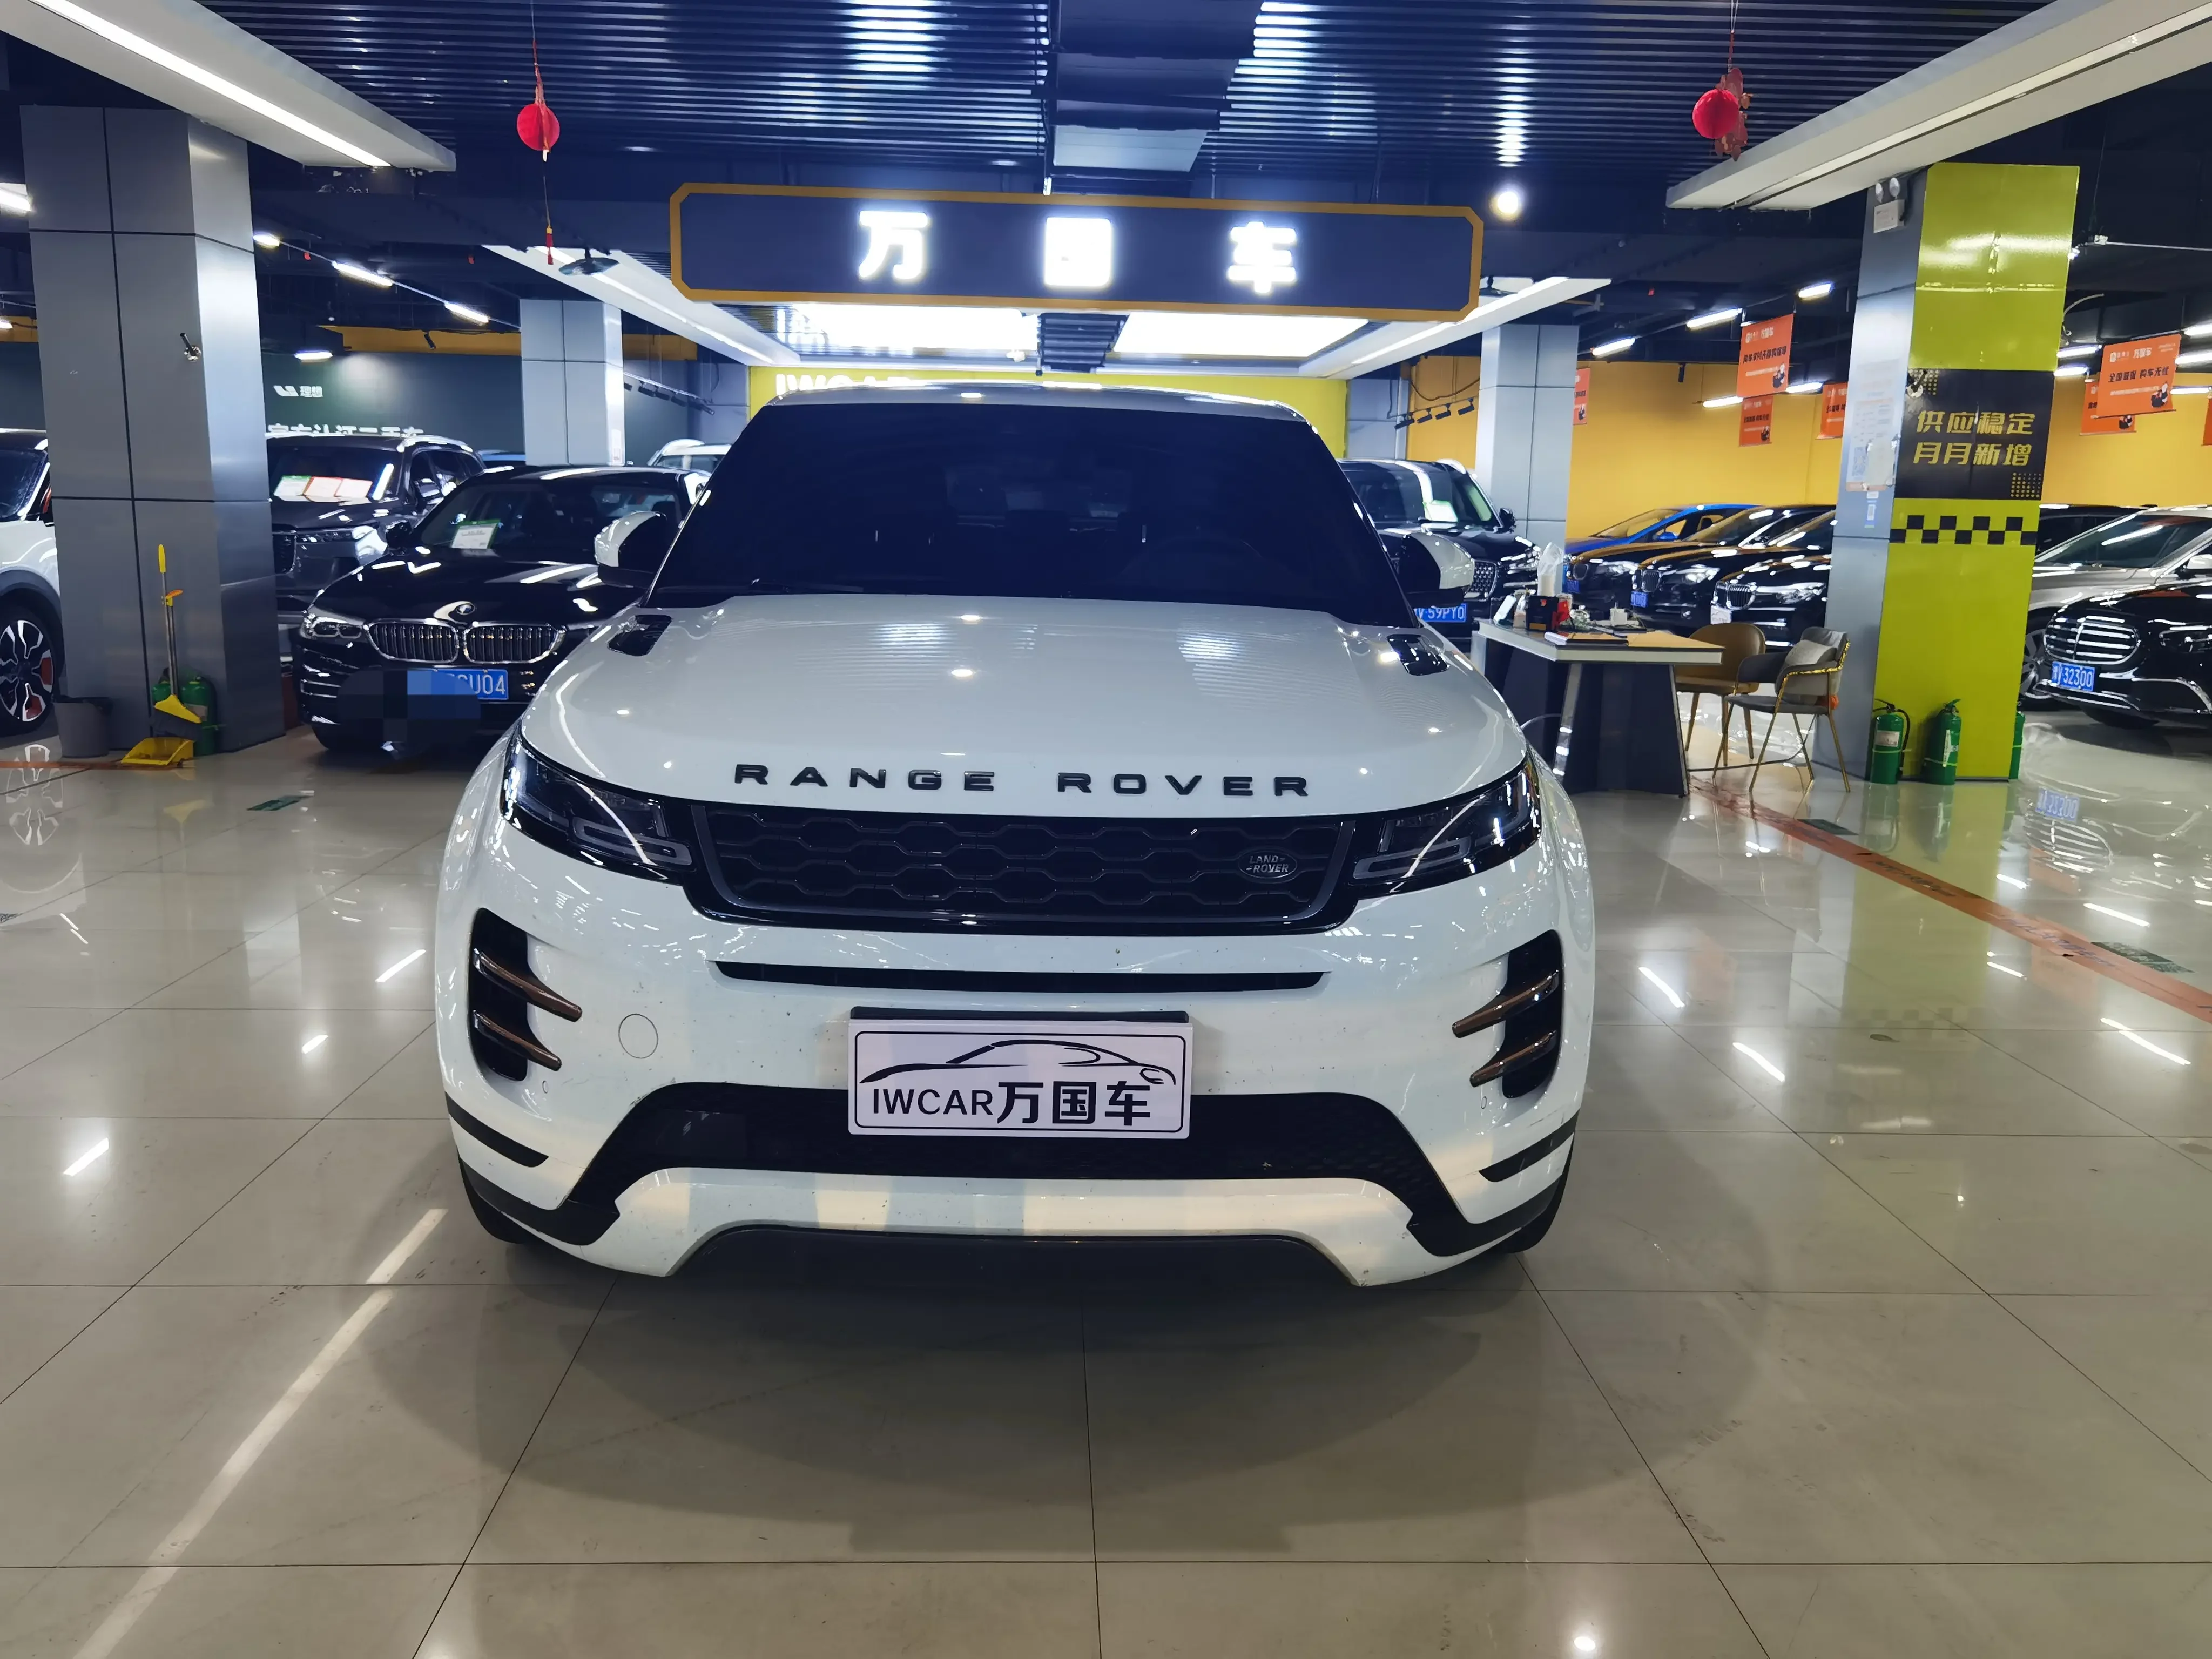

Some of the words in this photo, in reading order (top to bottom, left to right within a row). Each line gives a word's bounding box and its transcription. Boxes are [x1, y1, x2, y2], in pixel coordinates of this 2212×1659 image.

[1916, 410, 2035, 435] 供应稳定
[1913, 442, 2032, 466] 月月新增
[734, 764, 995, 792] RANGE
[1057, 772, 1309, 797] ROVER
[1249, 855, 1279, 864] LAND
[1253, 864, 1289, 873] ROVER
